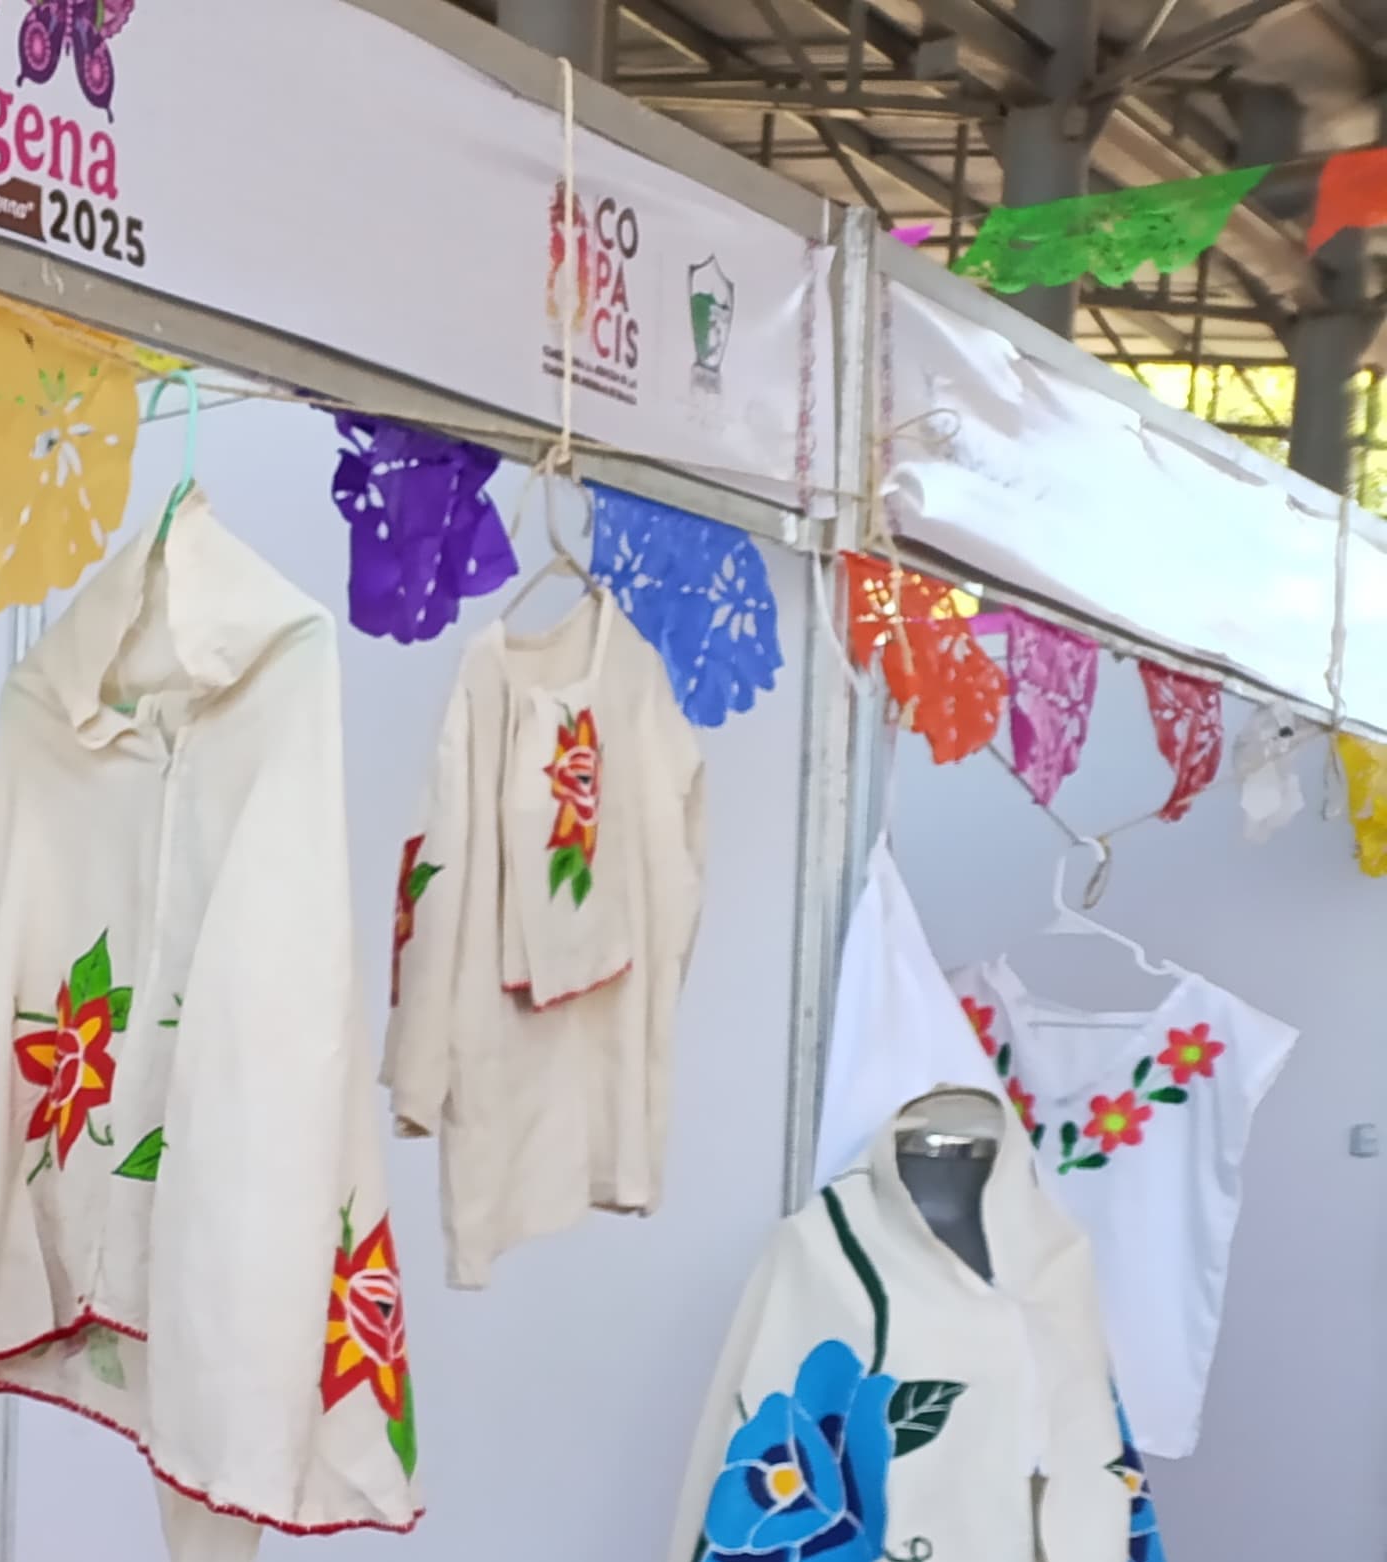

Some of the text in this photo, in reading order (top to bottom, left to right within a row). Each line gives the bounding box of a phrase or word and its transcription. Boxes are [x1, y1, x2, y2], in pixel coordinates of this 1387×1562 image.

[49, 189, 146, 267] 2025
[596, 197, 638, 259] CO
[595, 250, 629, 313] PA
[592, 306, 639, 369] CIS
